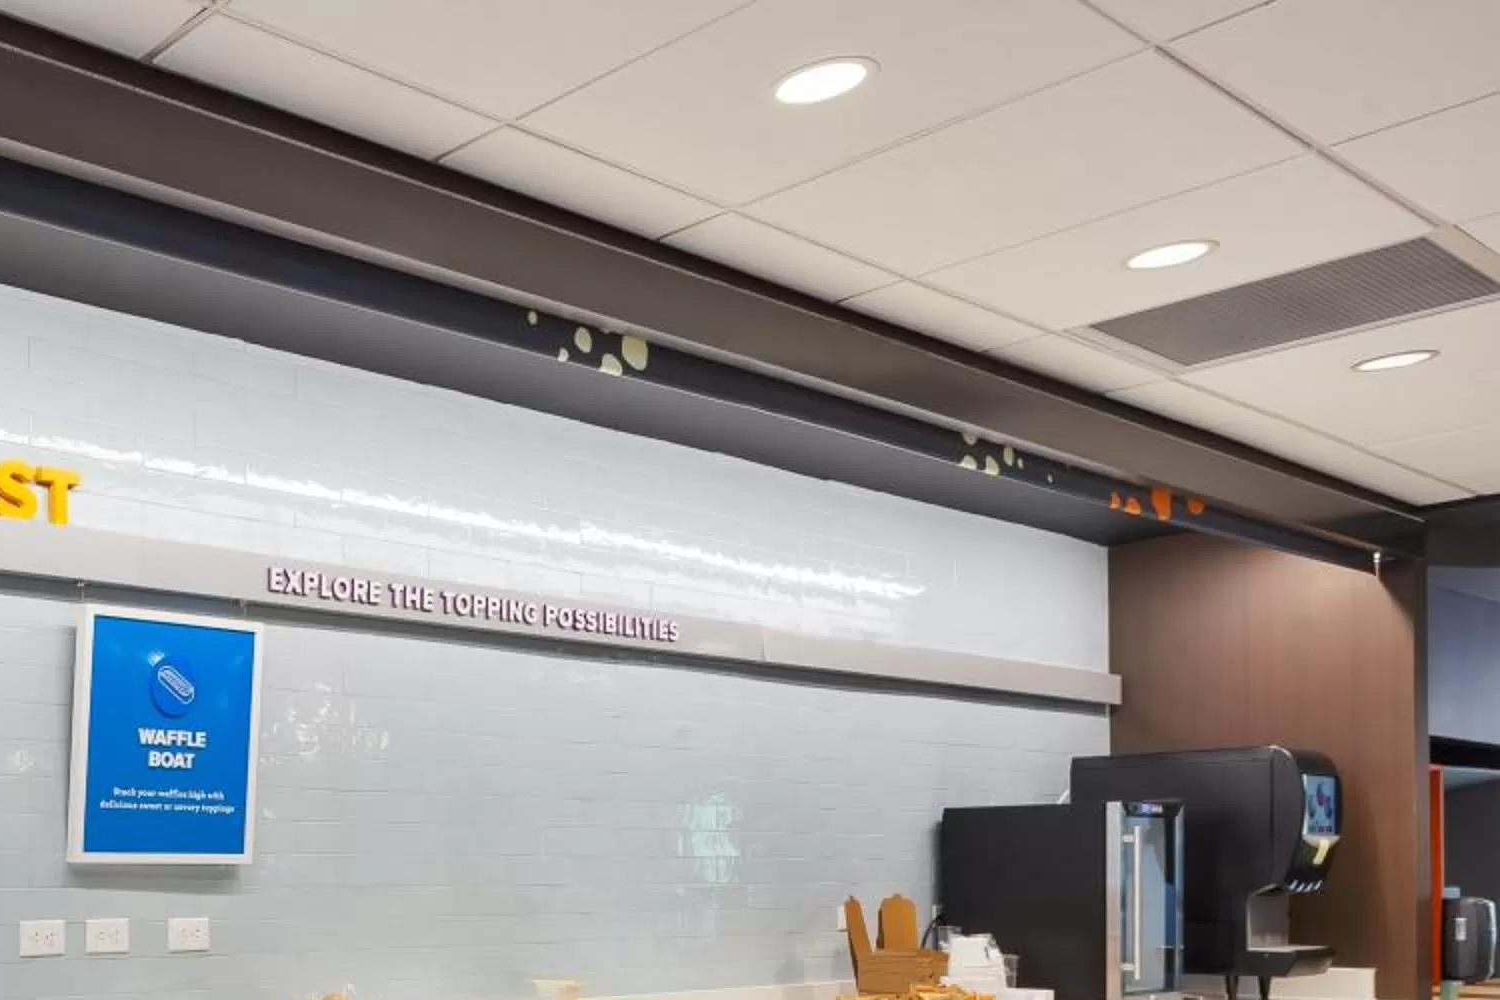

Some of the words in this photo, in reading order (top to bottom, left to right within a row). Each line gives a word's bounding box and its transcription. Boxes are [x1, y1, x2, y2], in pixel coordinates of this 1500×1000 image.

[267, 566, 382, 605] EXPLORE
[389, 582, 434, 612] THE
[440, 590, 538, 625] TOPPING
[543, 603, 680, 642] POSSIBILITIES
[138, 727, 208, 748] WAFFLE
[148, 751, 196, 769] BOAT
